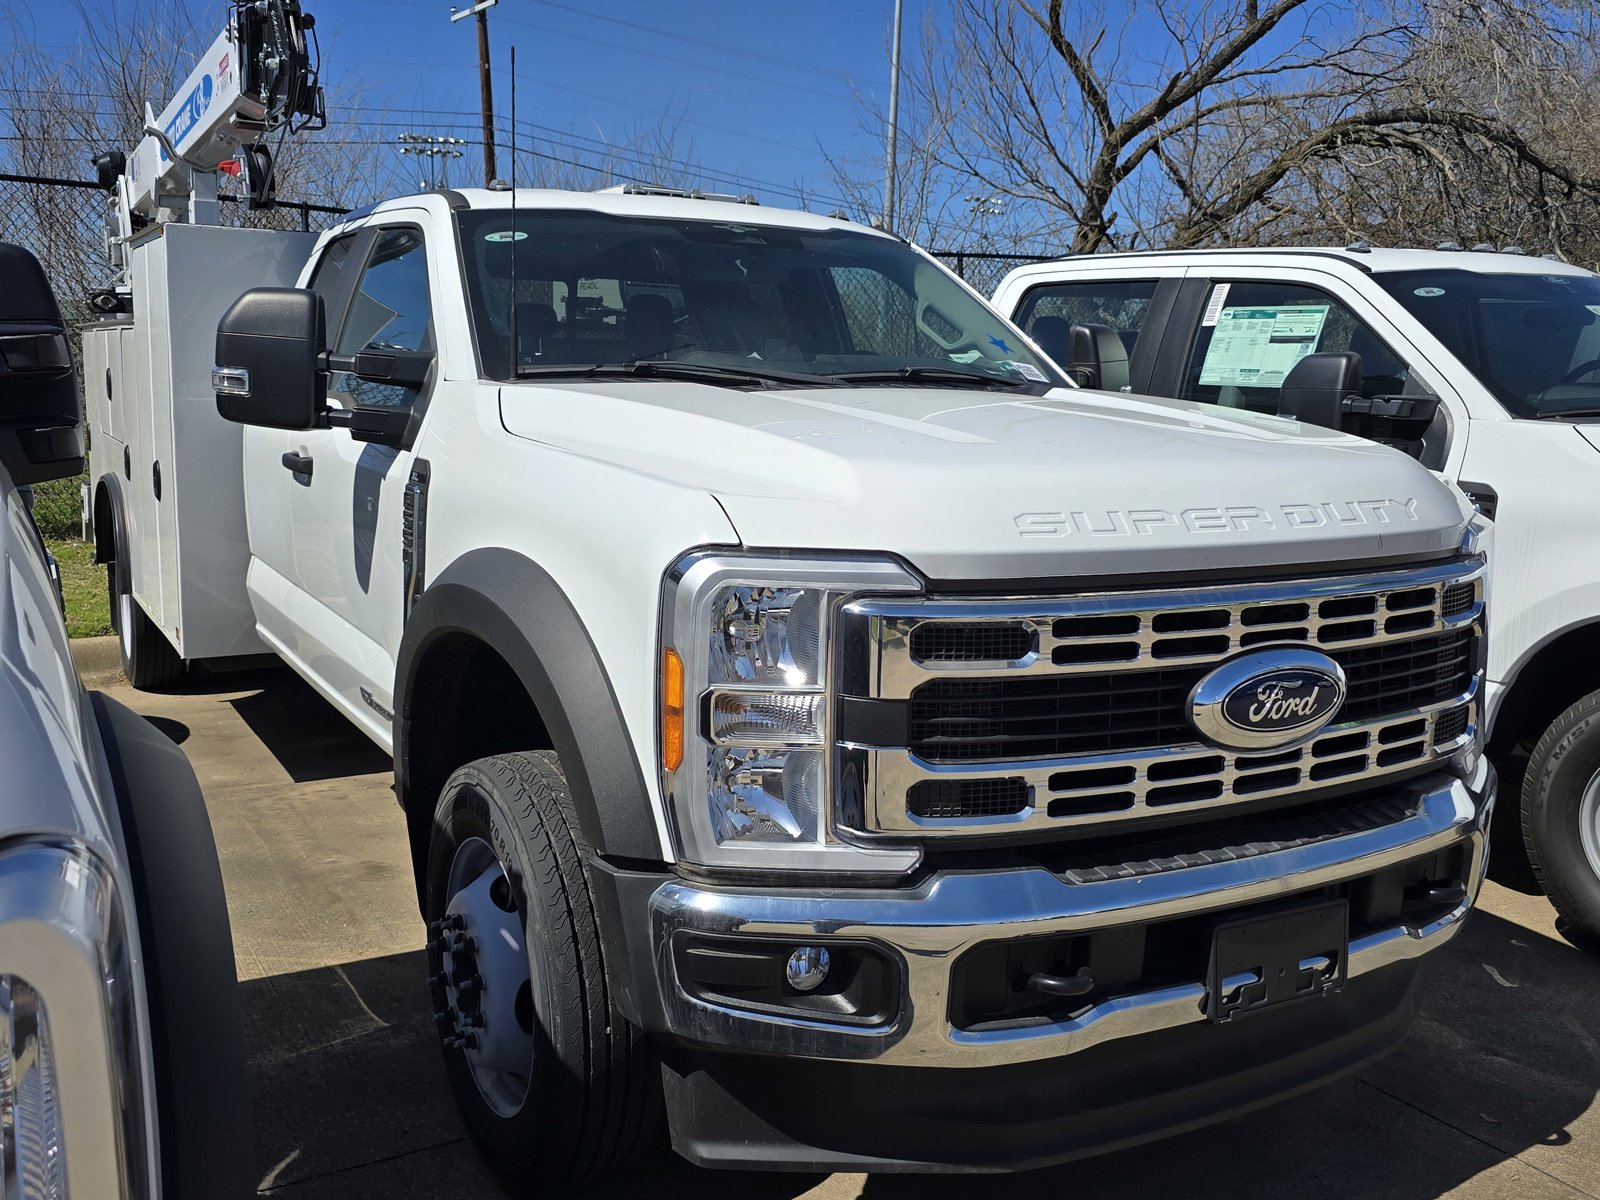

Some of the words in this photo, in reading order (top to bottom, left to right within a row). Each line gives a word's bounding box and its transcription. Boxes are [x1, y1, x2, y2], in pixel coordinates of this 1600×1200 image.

[1013, 506, 1276, 538] SUPER
[1280, 497, 1418, 529] DUTY
[1248, 680, 1320, 723] Ford
